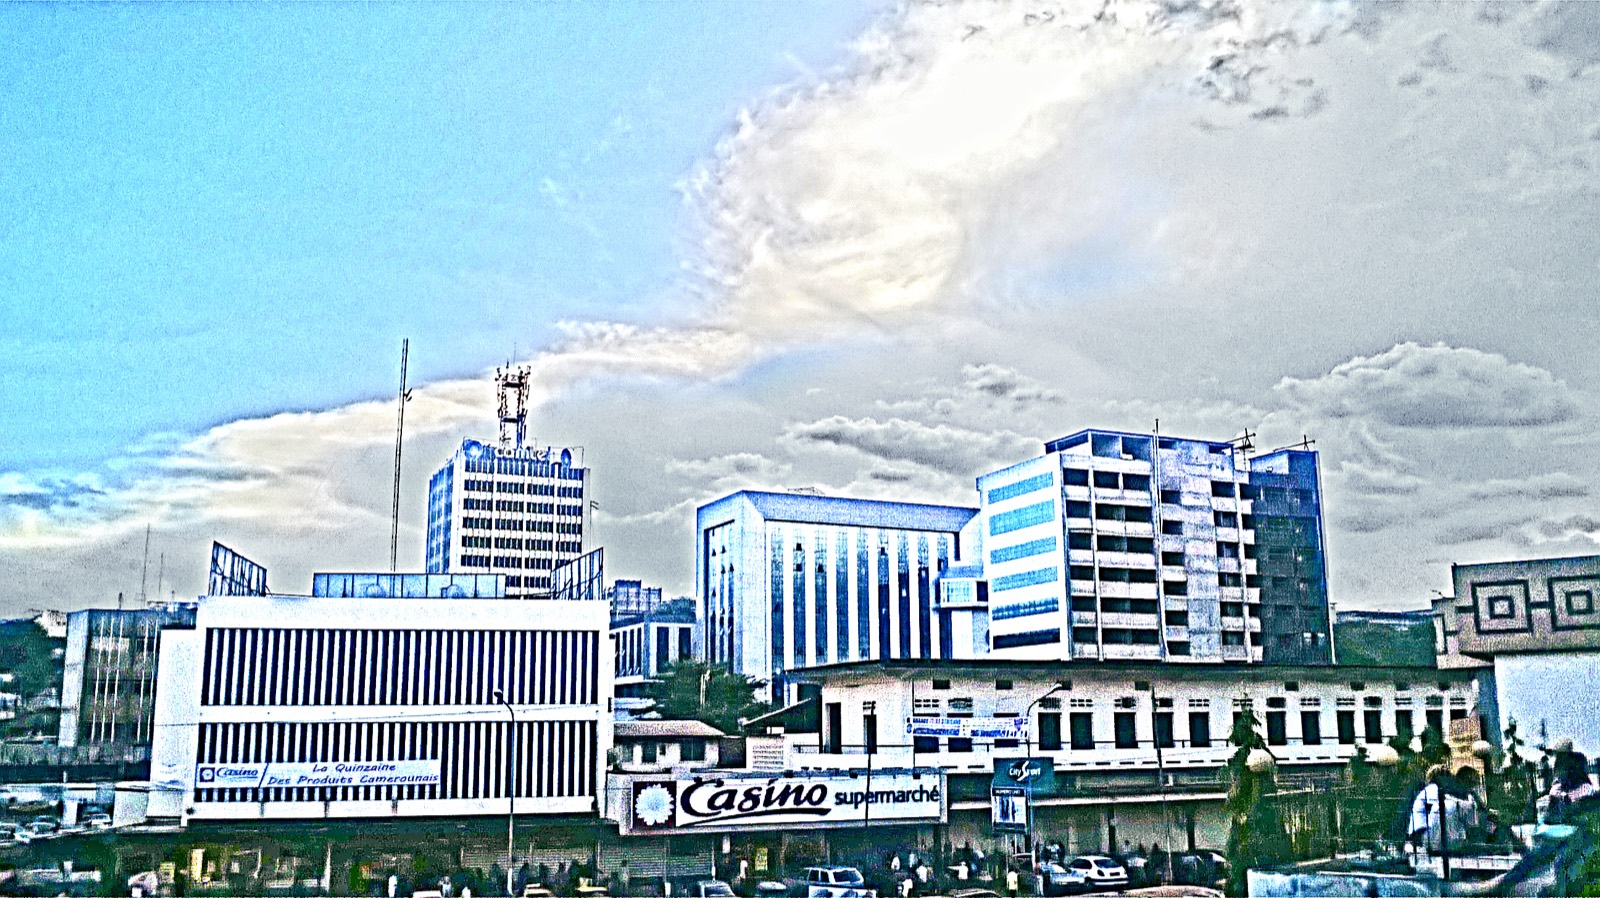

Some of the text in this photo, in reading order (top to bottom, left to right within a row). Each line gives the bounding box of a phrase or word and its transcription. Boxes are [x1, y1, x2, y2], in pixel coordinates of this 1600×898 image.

[216, 767, 259, 779] Casino
[335, 763, 397, 773] Quinzaine
[267, 774, 439, 786] Des Produits Camerounais
[680, 778, 940, 820] Casino supermarché
